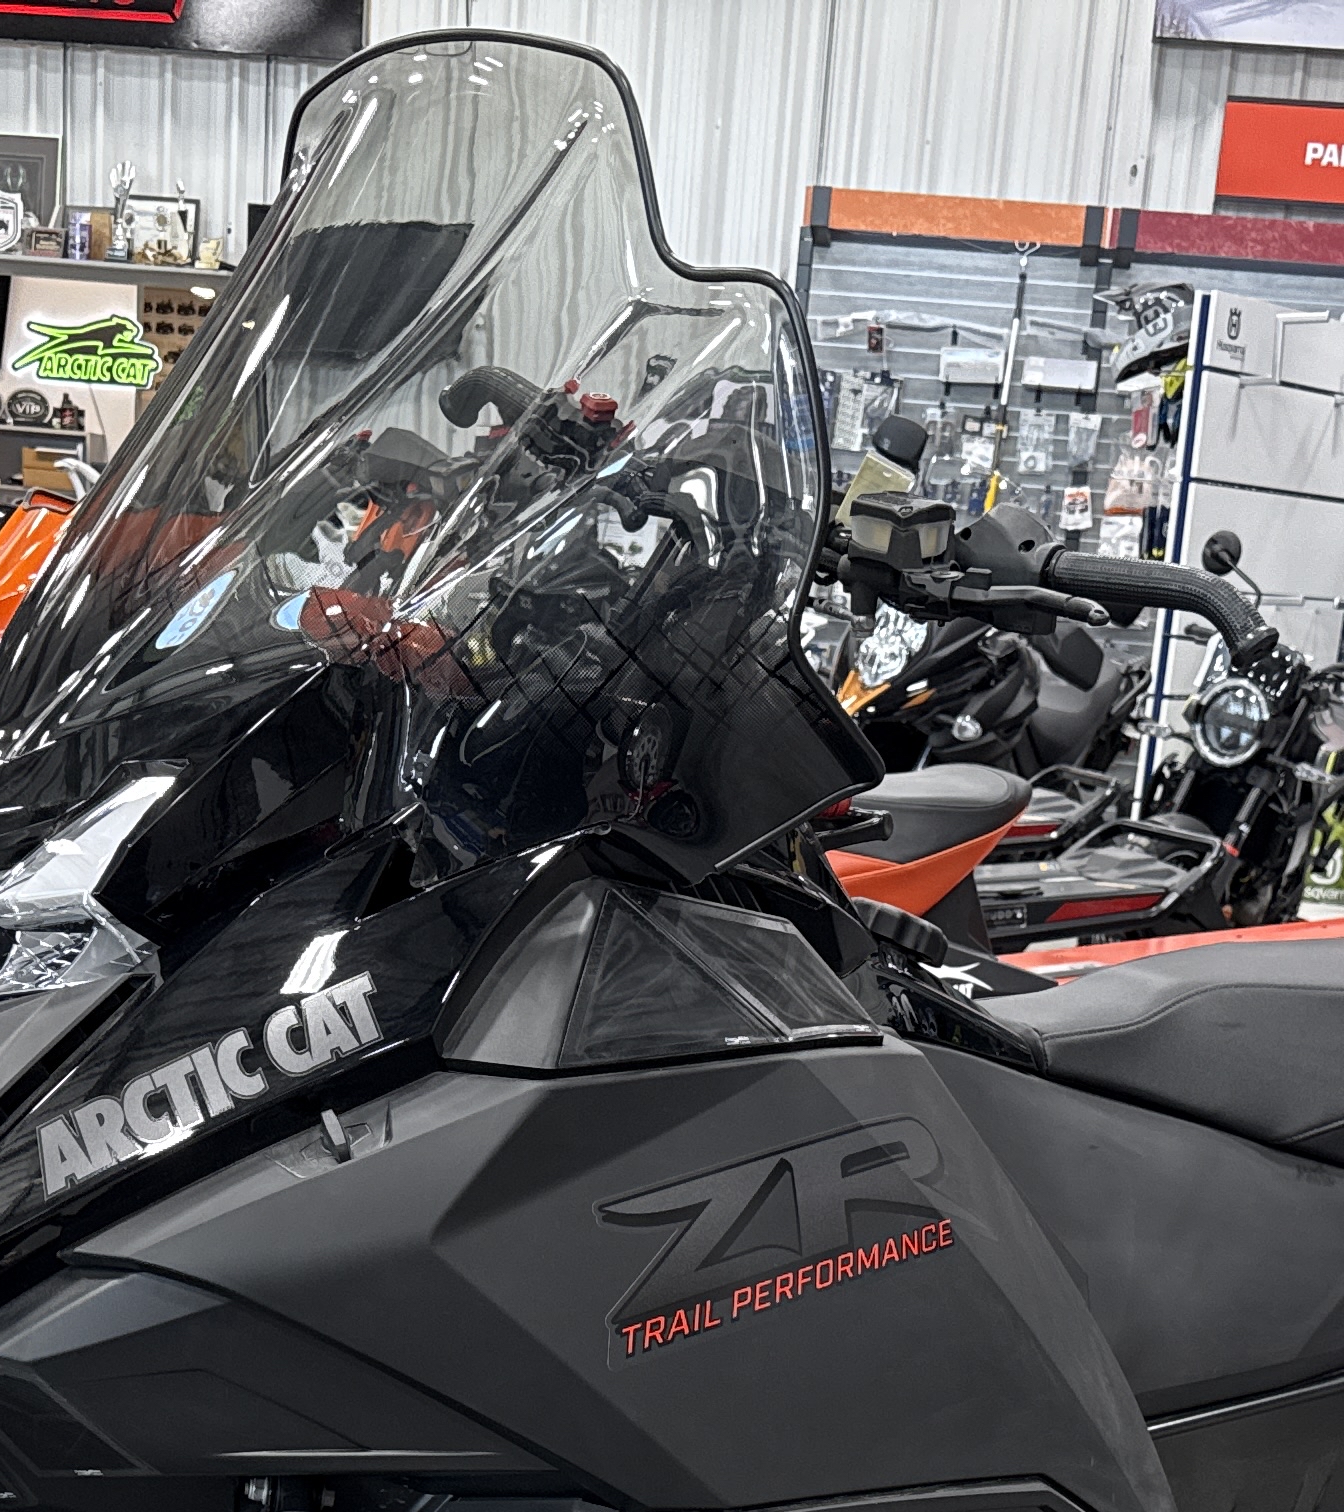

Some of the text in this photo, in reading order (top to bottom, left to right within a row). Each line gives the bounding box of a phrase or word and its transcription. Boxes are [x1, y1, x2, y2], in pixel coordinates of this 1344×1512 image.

[16, 402, 41, 414] VIP
[41, 353, 157, 385] ARCTIC CAT
[36, 971, 385, 1201] ARCTIC CAT
[621, 1218, 954, 1357] TRAIL PERFORMANCE
